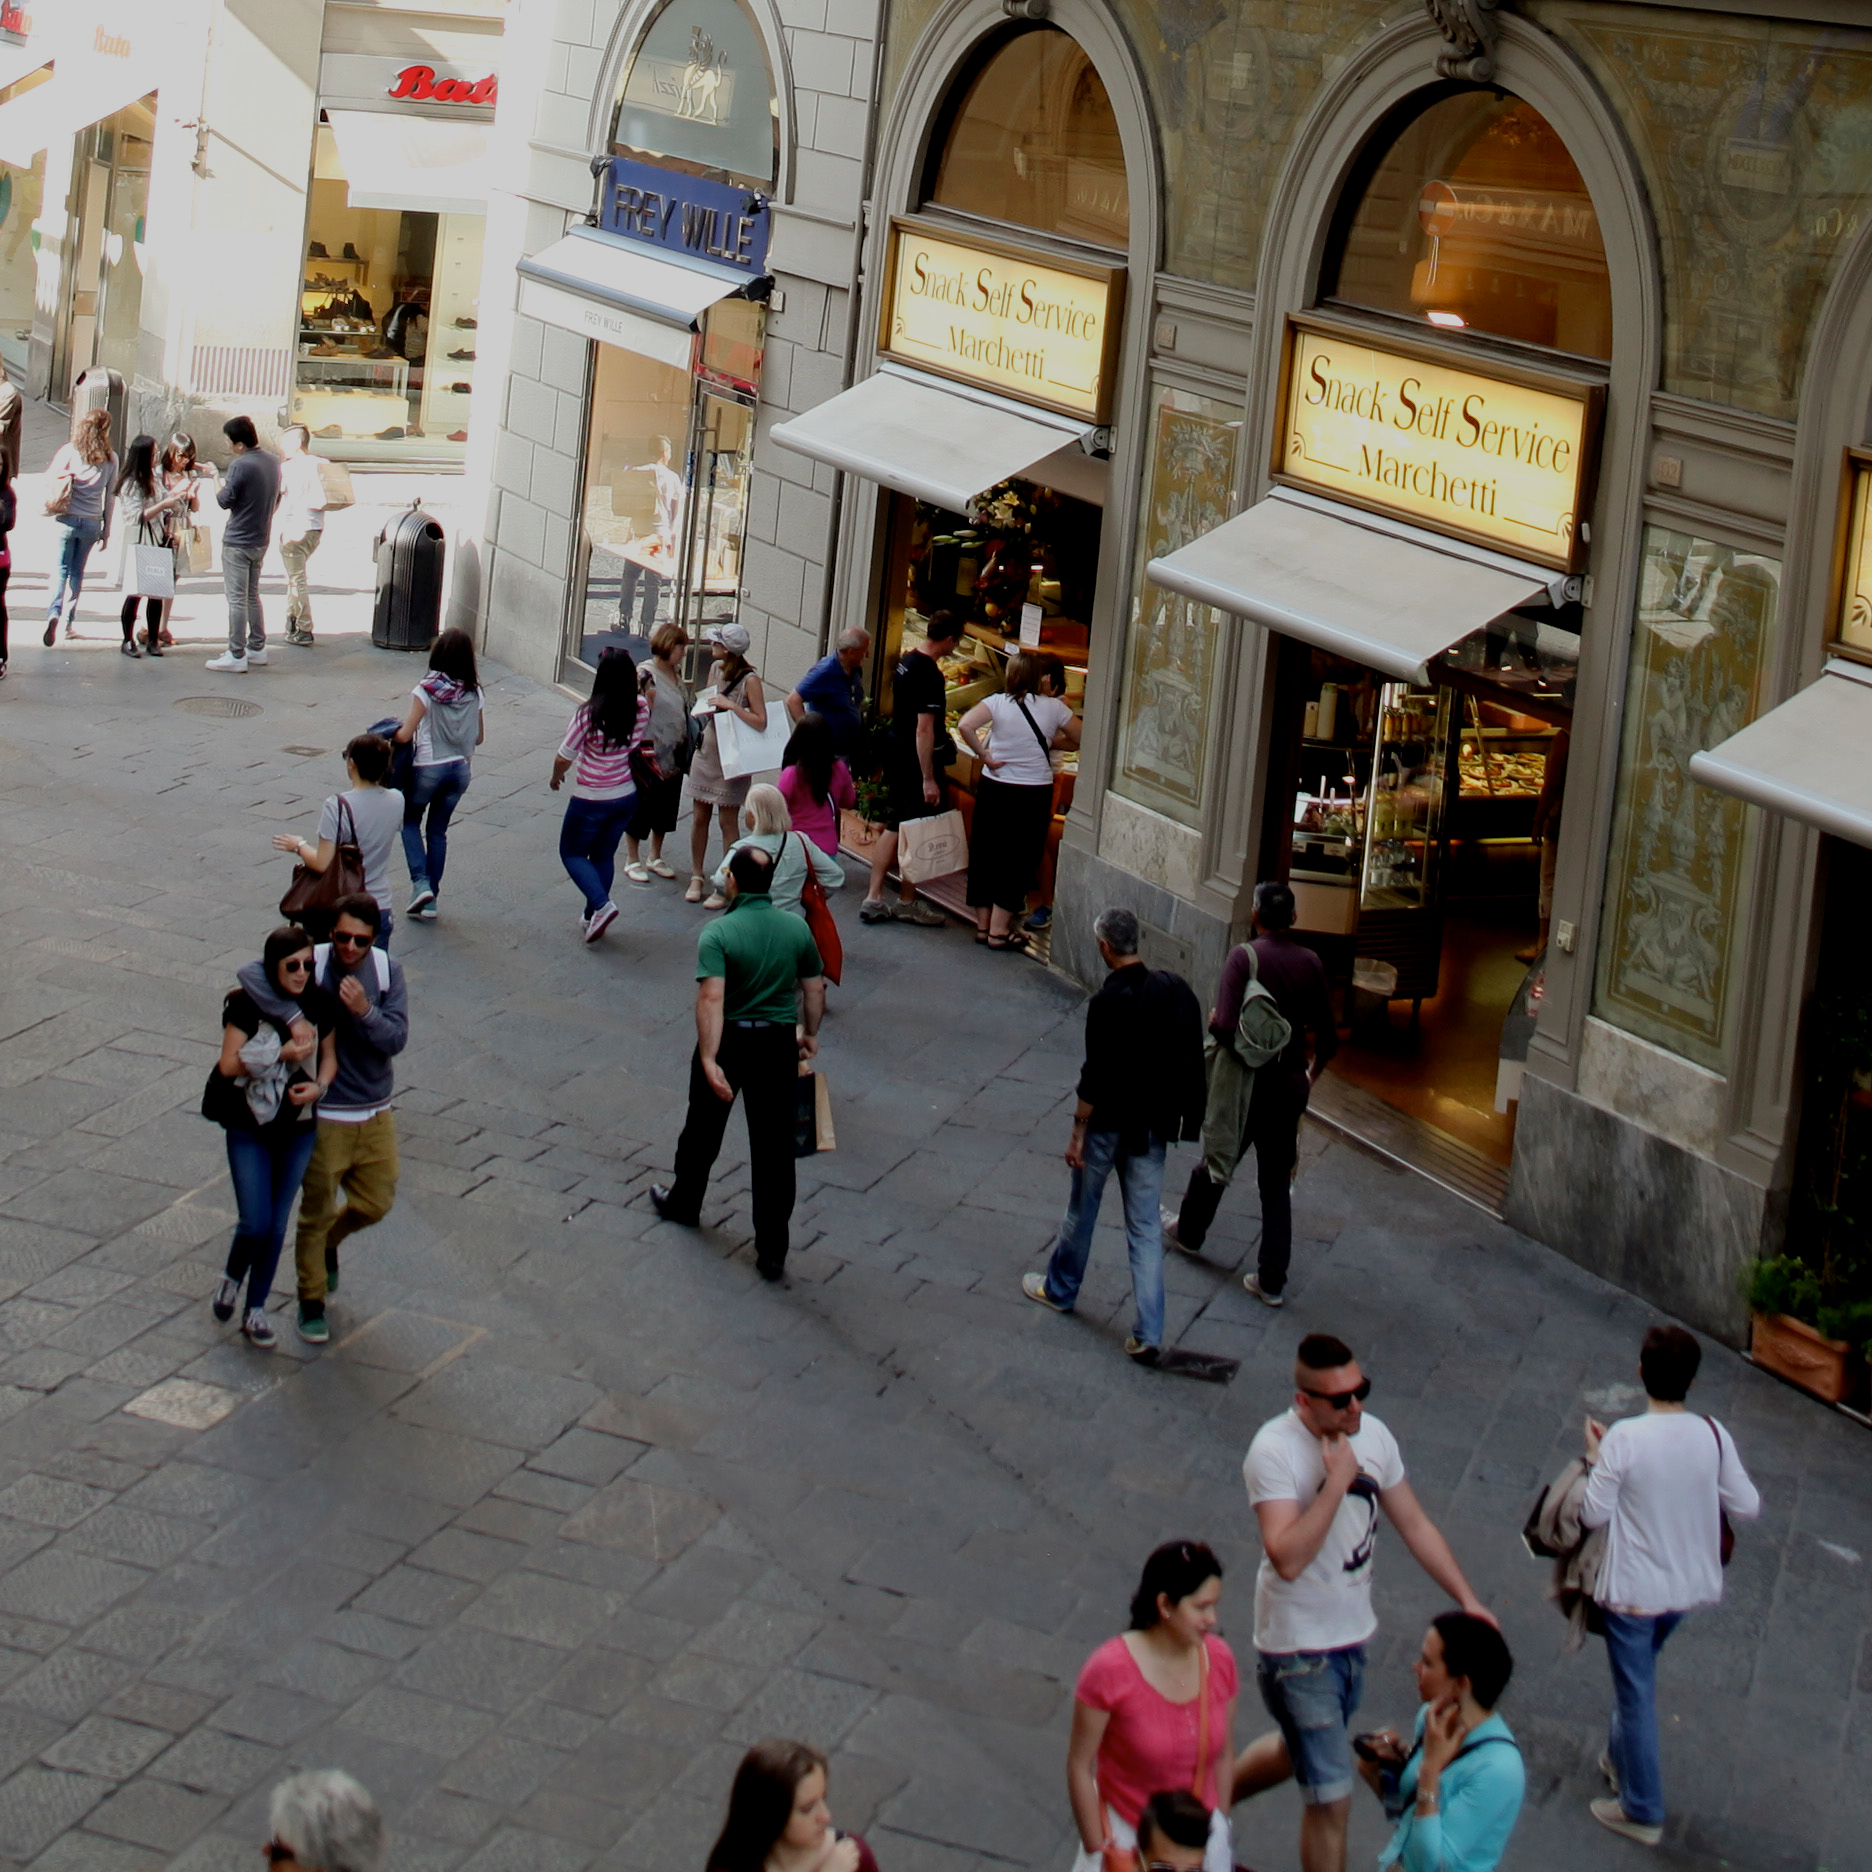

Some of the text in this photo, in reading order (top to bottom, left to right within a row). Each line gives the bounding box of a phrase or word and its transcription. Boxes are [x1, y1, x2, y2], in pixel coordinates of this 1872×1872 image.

[386, 64, 500, 104] Bat
[614, 183, 756, 265] FREY WILLE
[584, 310, 624, 334] FREY WILLE
[910, 251, 1096, 342] Snack Self Service
[947, 325, 1045, 380] Marchetti
[1304, 354, 1571, 474] Snack Self Service
[1358, 444, 1497, 516] Marchetti
